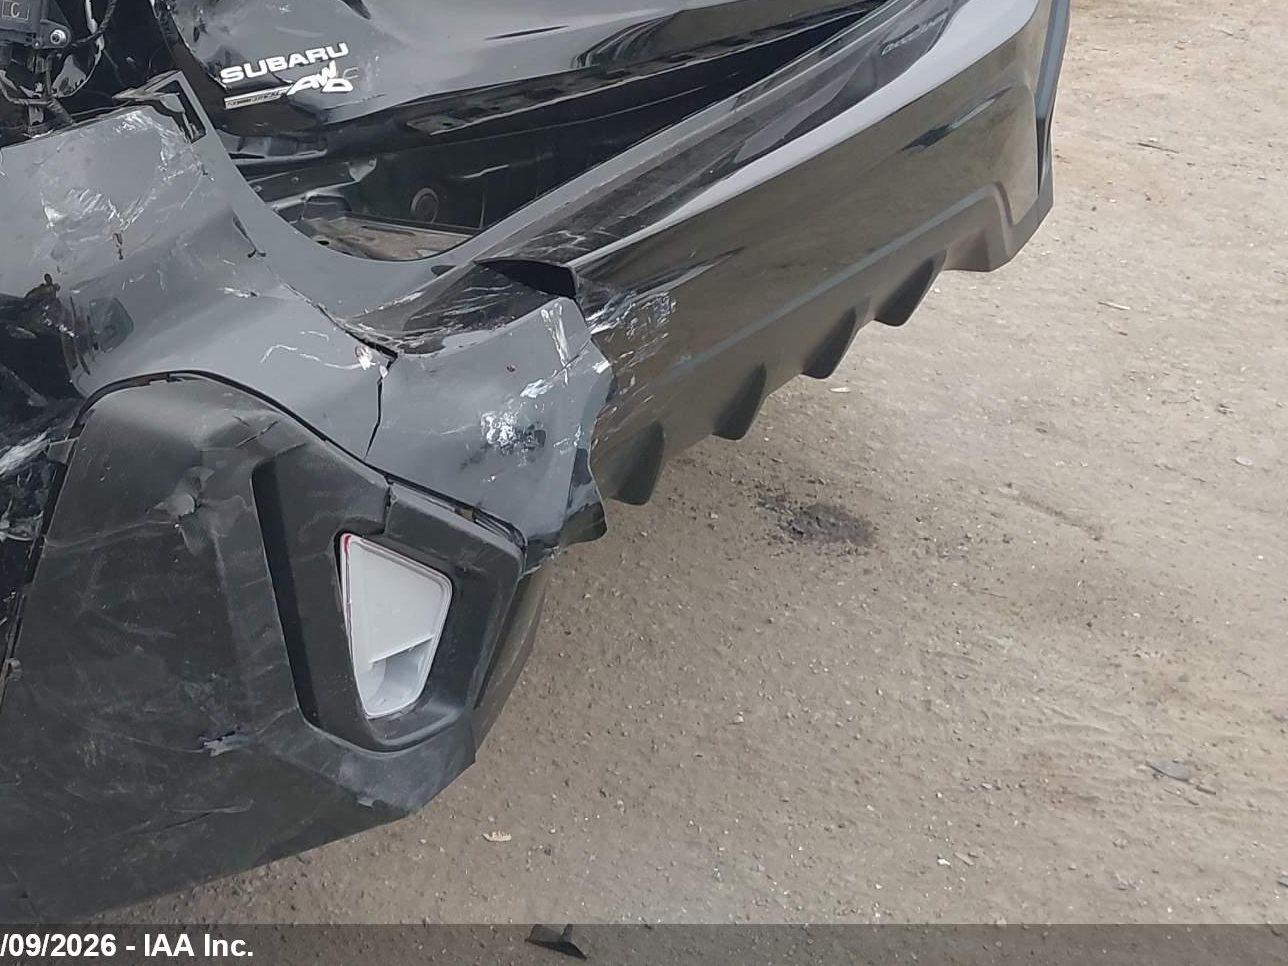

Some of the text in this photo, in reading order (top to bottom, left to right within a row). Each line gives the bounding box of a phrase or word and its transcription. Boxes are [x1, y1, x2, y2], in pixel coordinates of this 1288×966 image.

[10, 2, 21, 18] C
[220, 42, 350, 84] SUBARU
[287, 60, 354, 96] AWD
